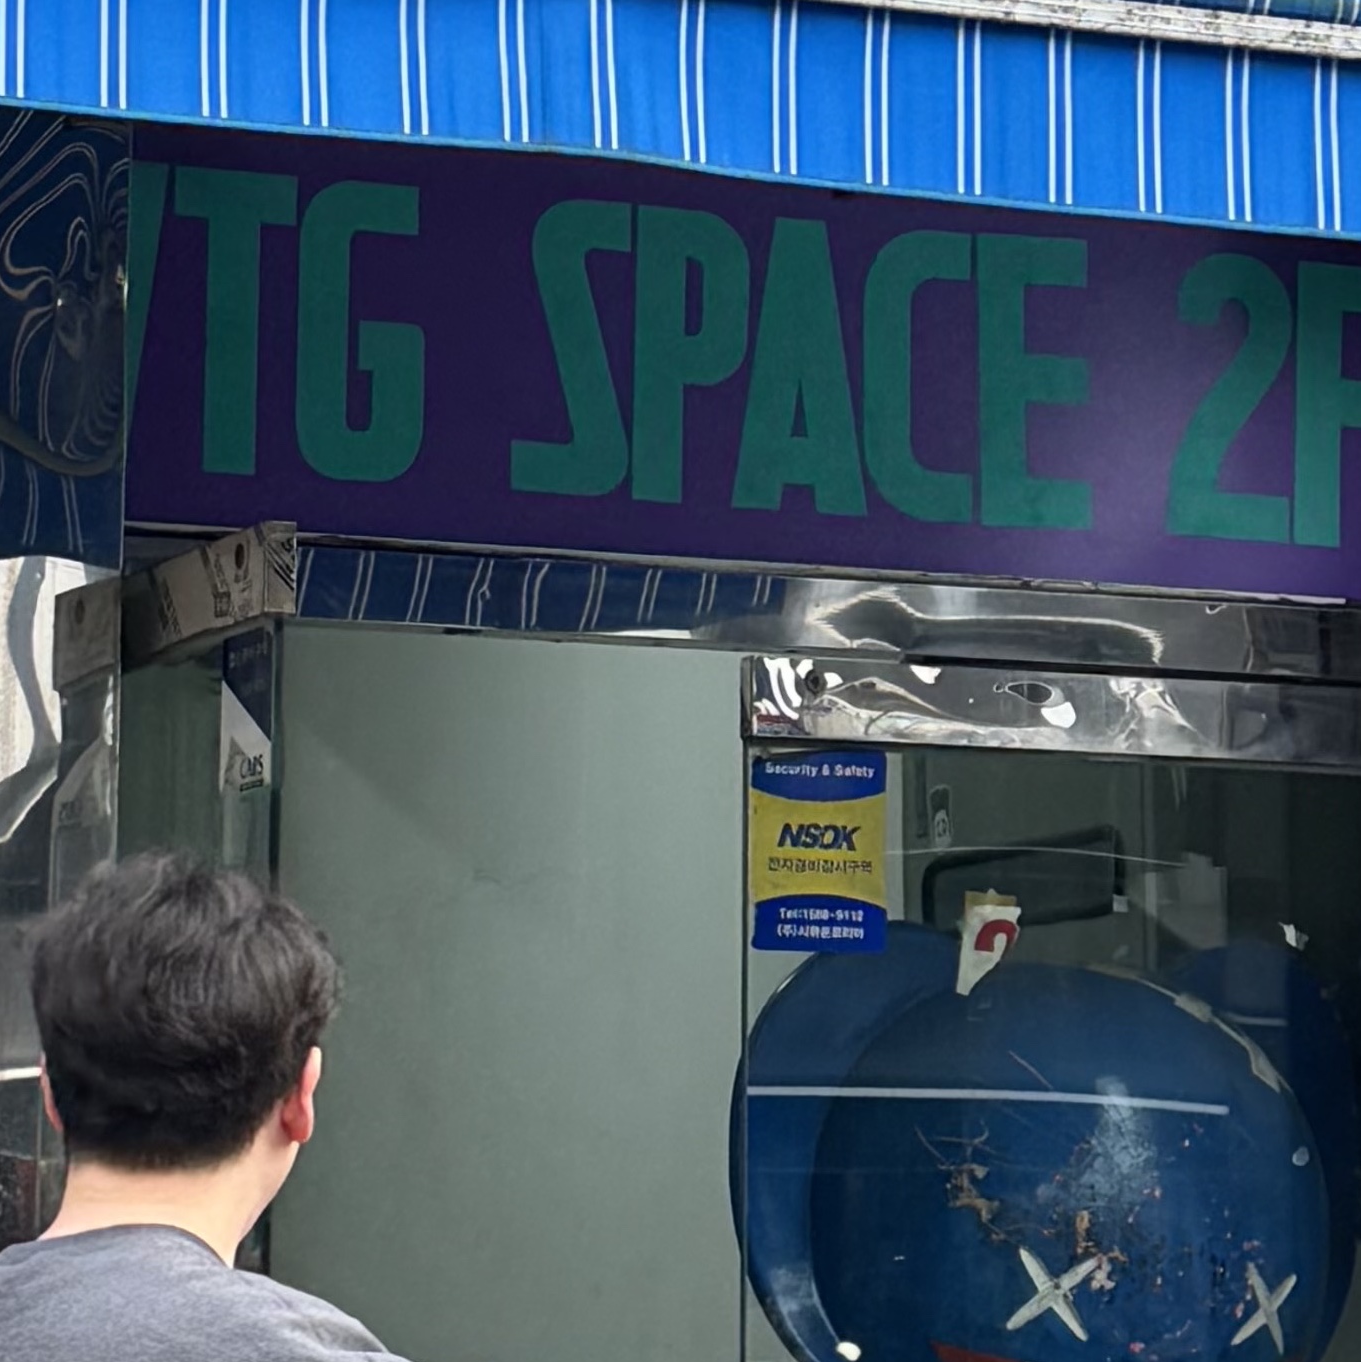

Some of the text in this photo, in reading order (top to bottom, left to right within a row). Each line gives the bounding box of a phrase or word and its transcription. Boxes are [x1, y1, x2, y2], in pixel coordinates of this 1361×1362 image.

[510, 199, 1094, 530] SPACE
[765, 761, 818, 778] Security
[834, 763, 876, 779] Safety
[777, 822, 862, 851] NSOK
